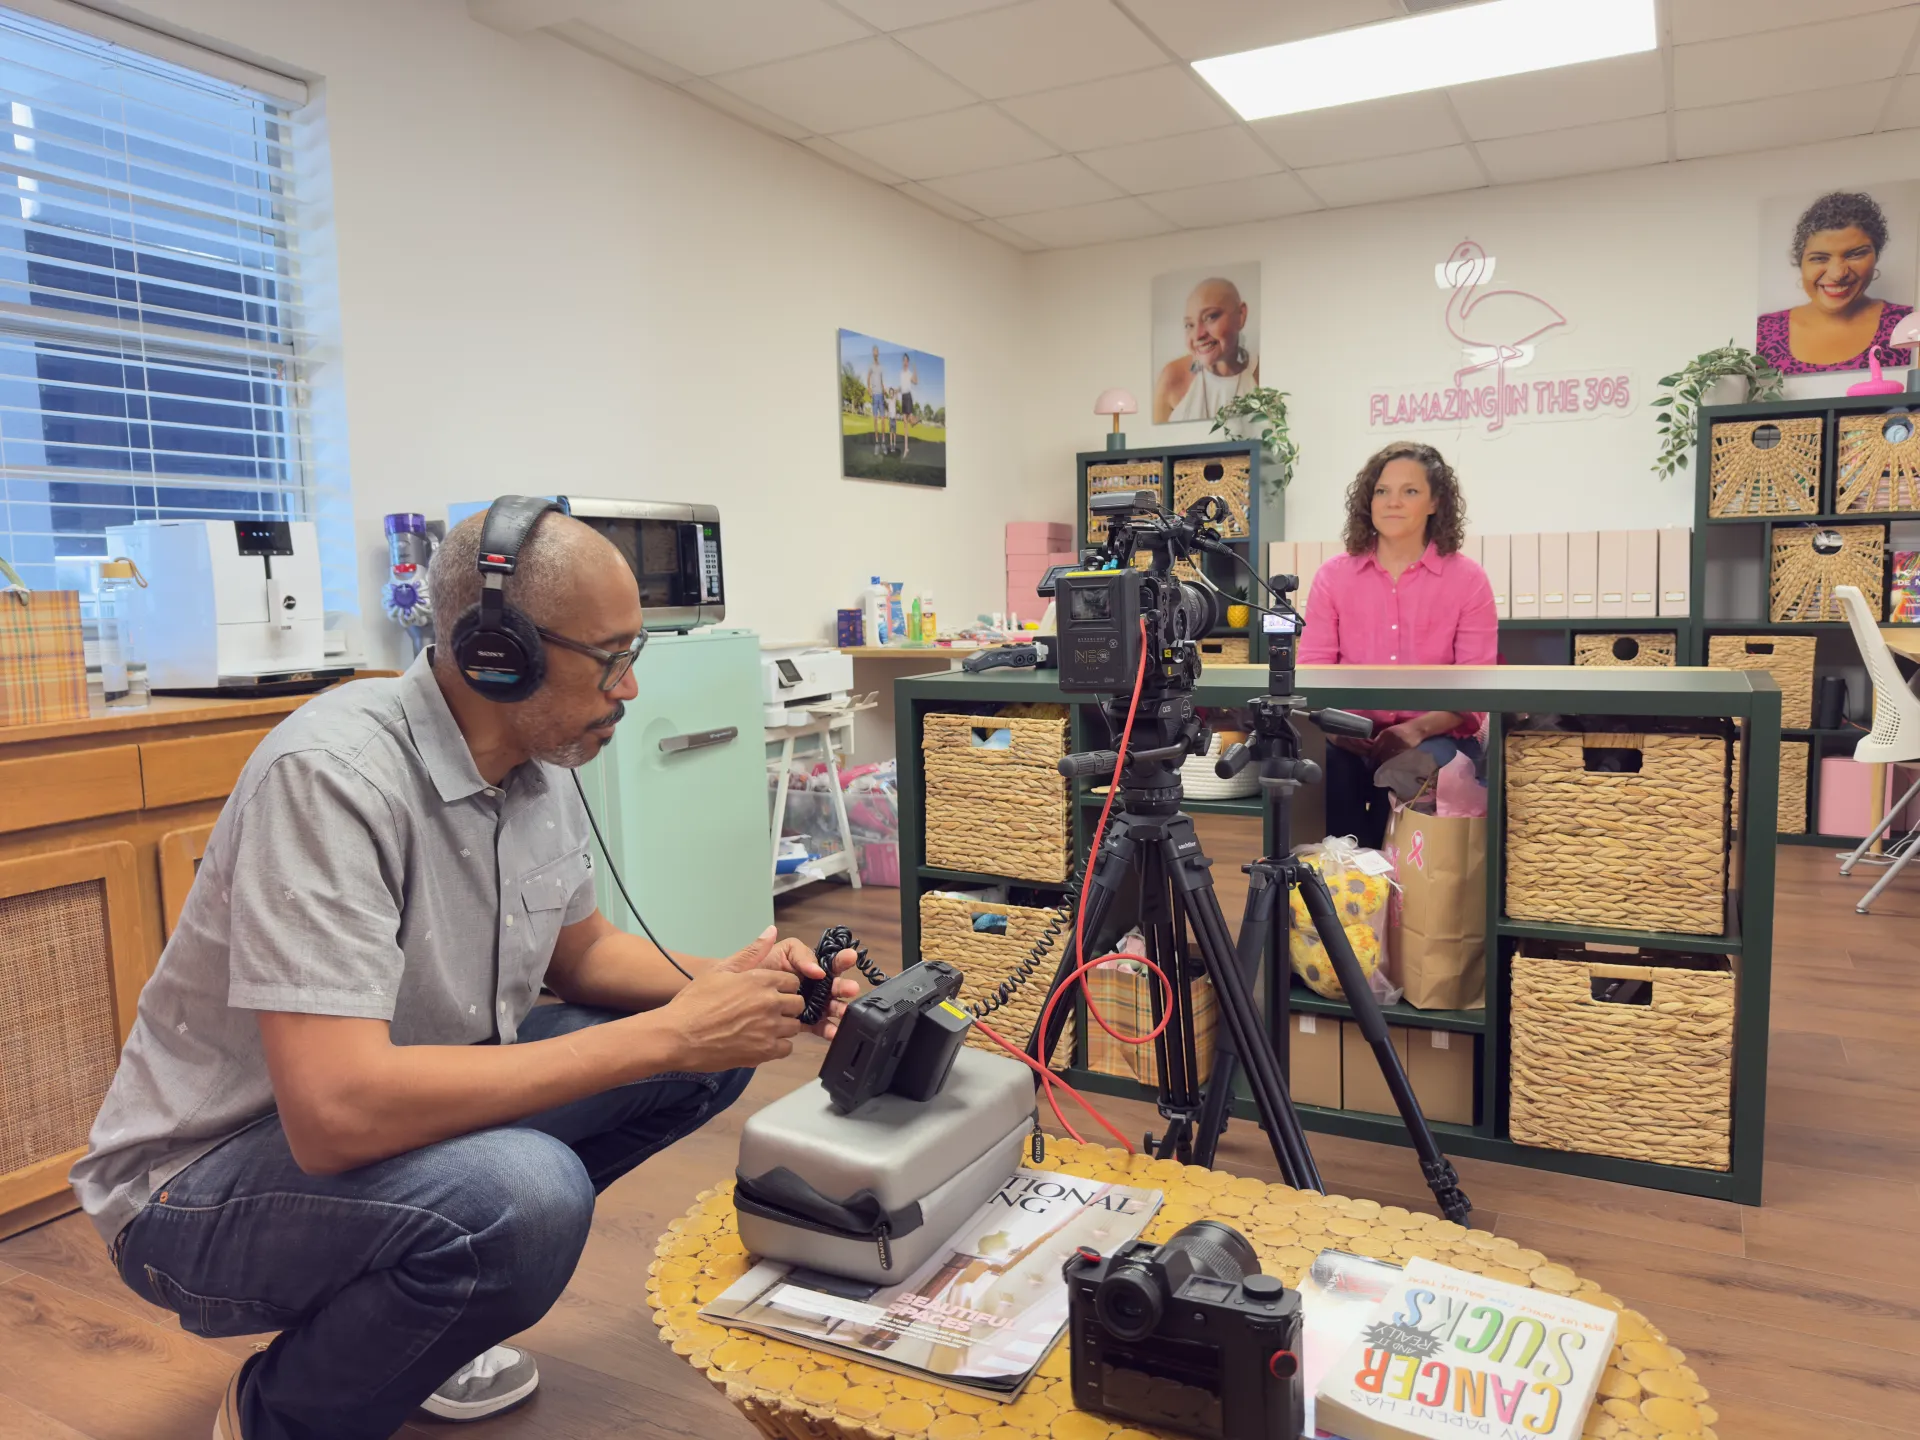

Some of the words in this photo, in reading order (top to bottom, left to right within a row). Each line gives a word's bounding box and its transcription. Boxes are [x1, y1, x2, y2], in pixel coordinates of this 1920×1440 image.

[1370, 386, 1496, 426] FLAMAZING
[1504, 383, 1528, 416] IN
[1534, 379, 1580, 414] THE
[1584, 376, 1630, 410] 305
[878, 1236, 888, 1268] ATOMOS
[886, 1302, 973, 1332] SPACES
[896, 1292, 1017, 1331] BEAUTIFUL
[1375, 1325, 1433, 1351] REALLY
[1375, 1337, 1390, 1346] IT
[1392, 1288, 1585, 1386] SUCKS
[1393, 1342, 1416, 1354] AND
[1350, 1389, 1396, 1411] HAS
[1354, 1347, 1562, 1435] CANCER
[1404, 1405, 1490, 1434] PARENT
